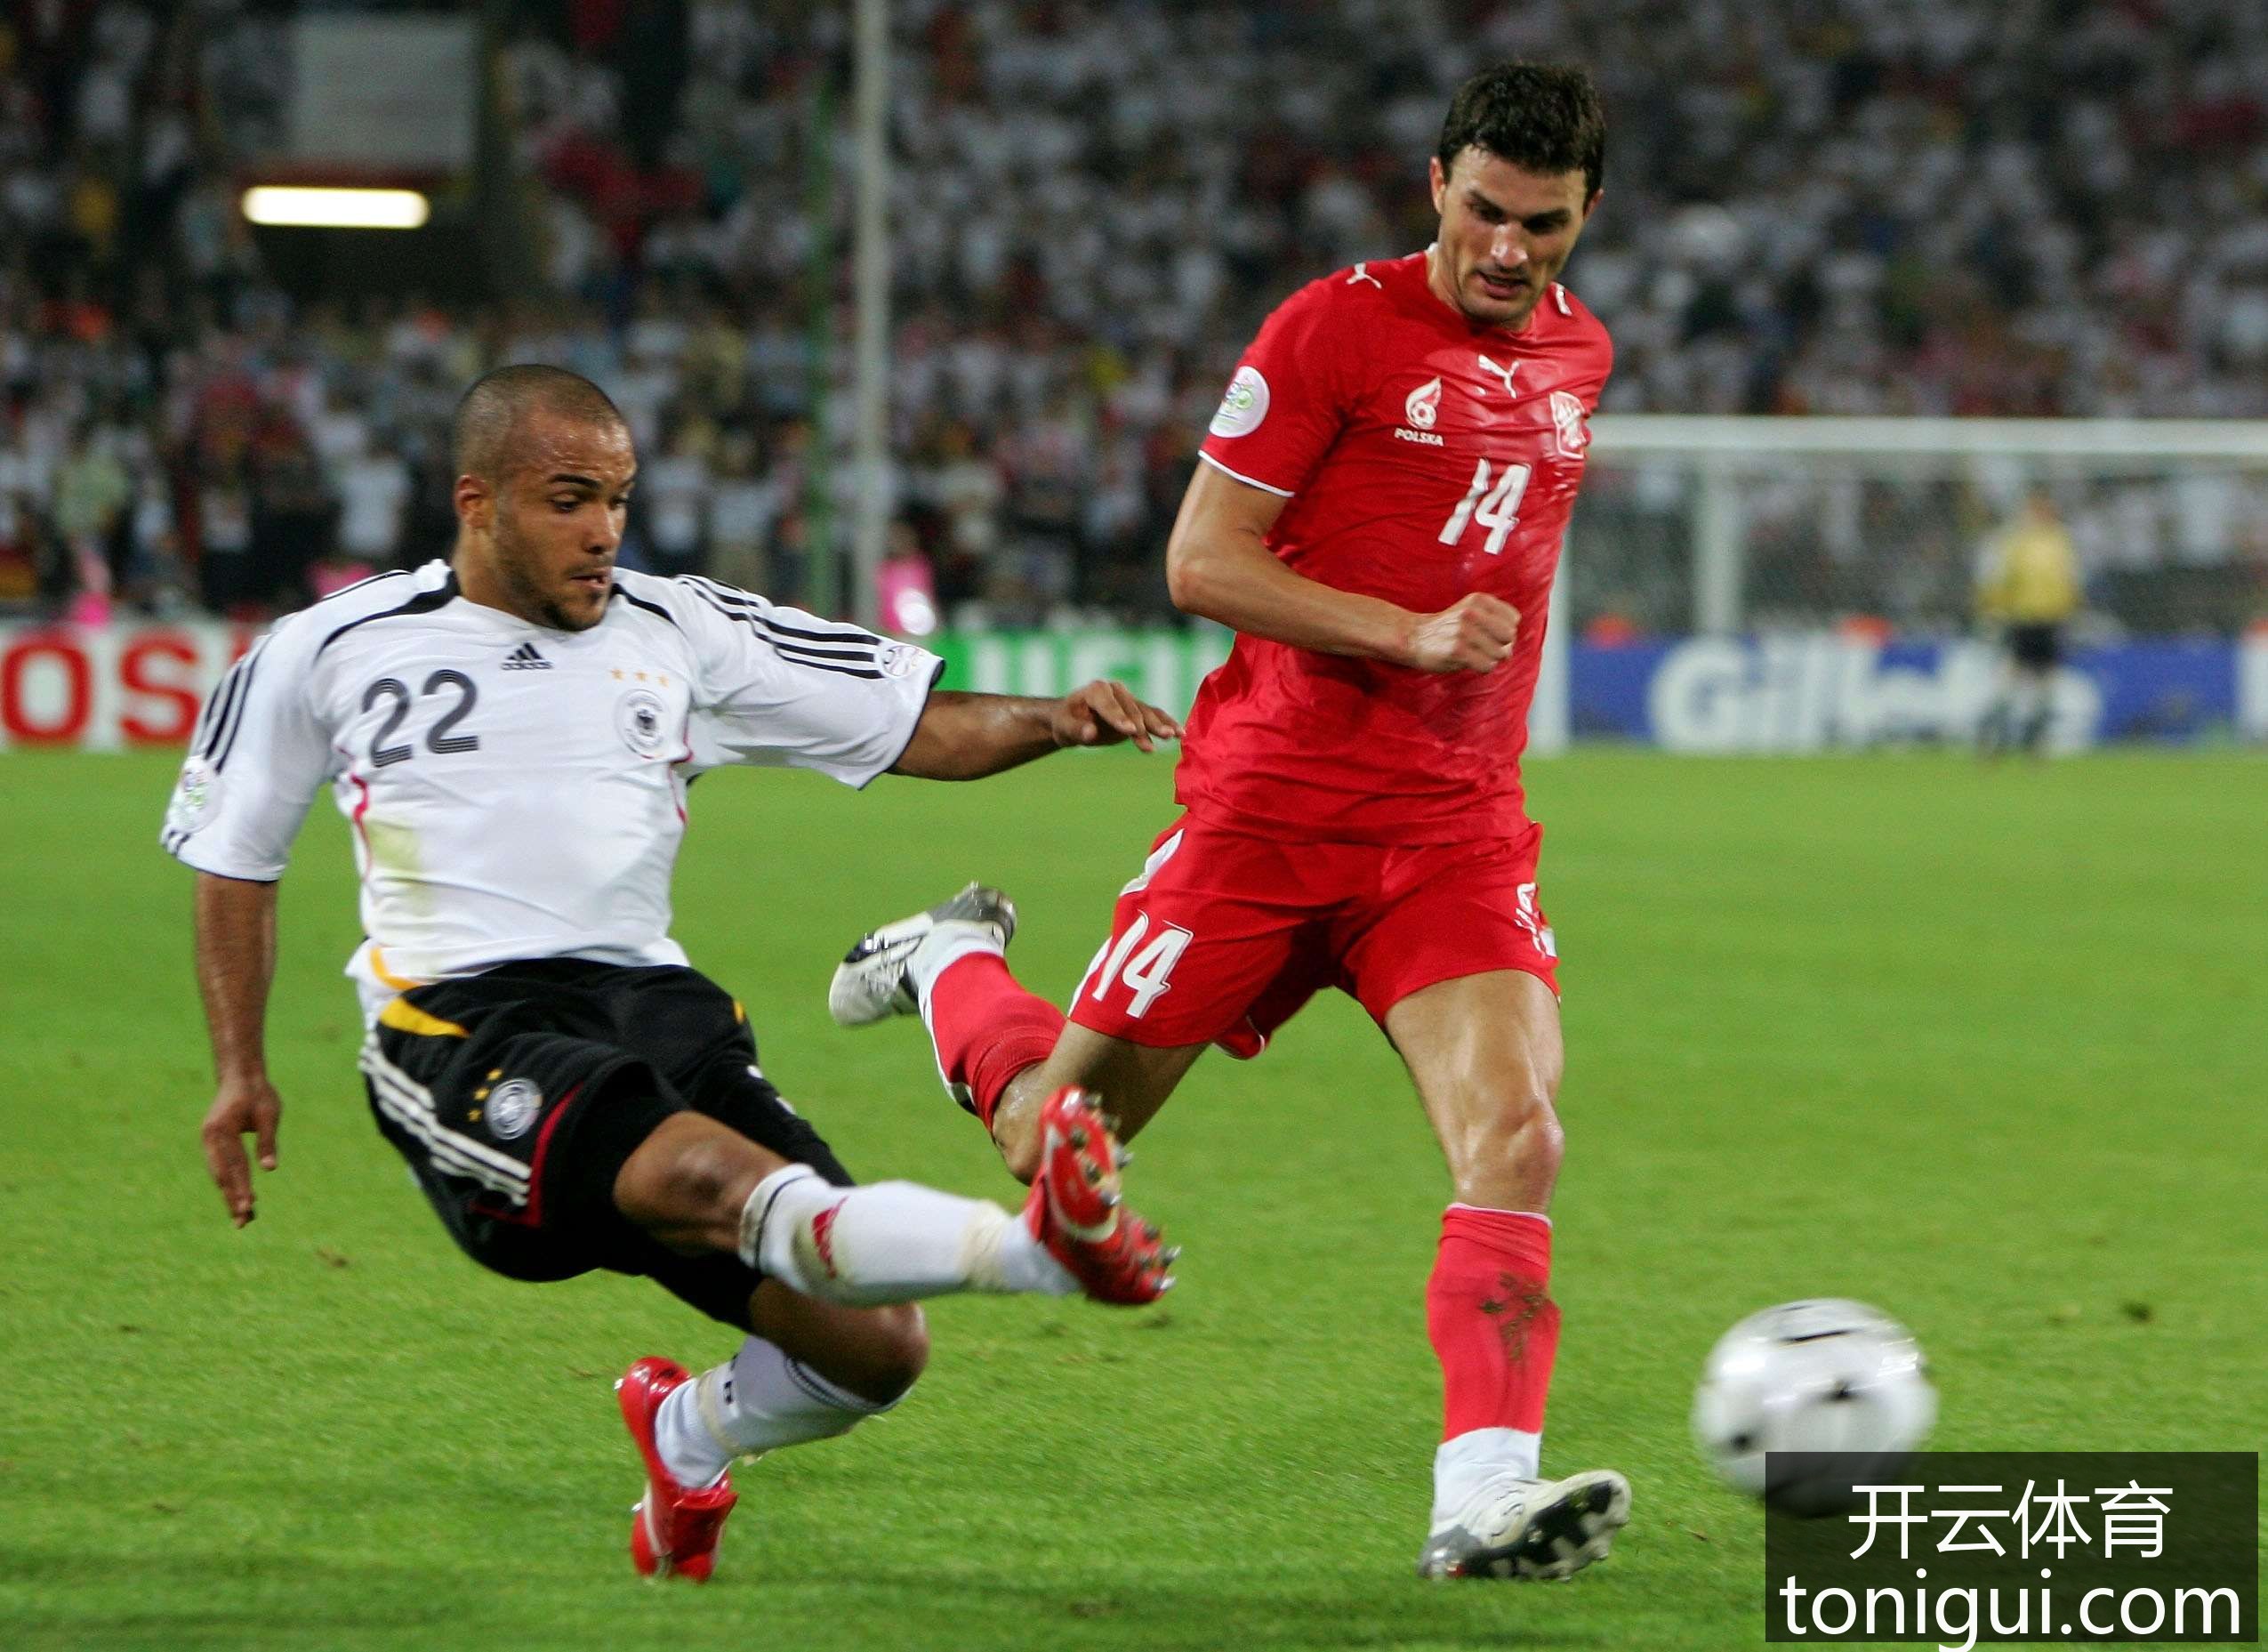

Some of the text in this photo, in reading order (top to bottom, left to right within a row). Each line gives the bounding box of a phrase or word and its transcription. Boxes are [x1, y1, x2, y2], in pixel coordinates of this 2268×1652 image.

[1394, 427, 1444, 447] POLSKA
[1437, 455, 1532, 555] 14
[0, 630, 253, 748] OS
[361, 668, 479, 768] 22
[1092, 908, 1194, 1019] 14
